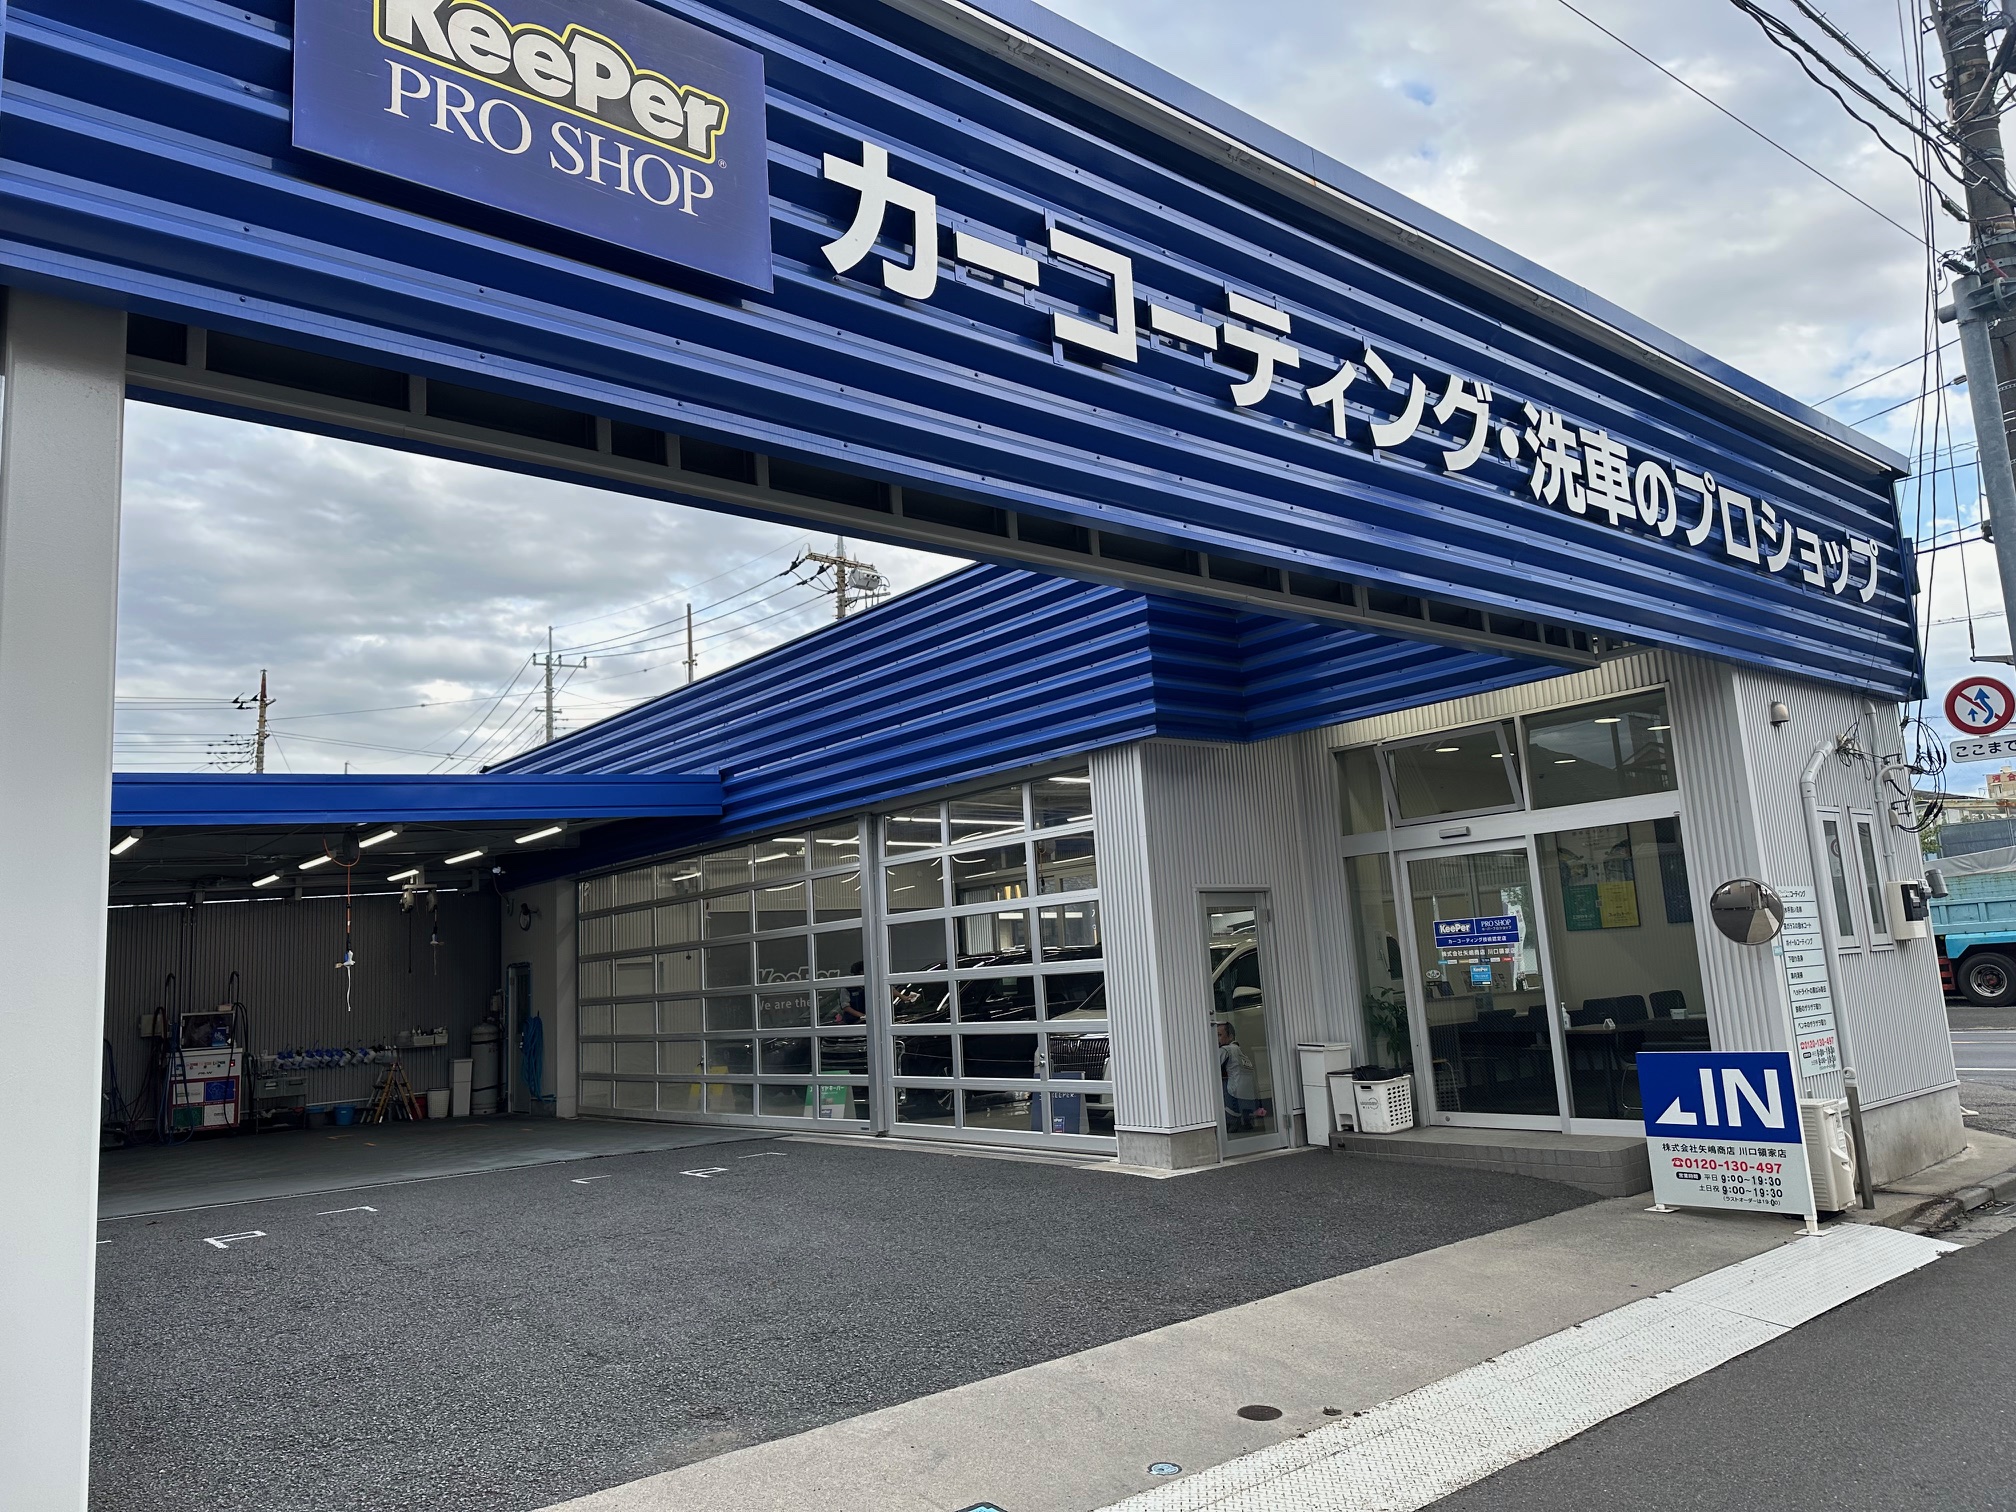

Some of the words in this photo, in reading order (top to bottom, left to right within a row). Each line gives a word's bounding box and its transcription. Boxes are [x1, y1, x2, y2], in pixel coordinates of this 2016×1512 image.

[385, 0, 721, 154] KeePer
[383, 59, 533, 156] PRO
[549, 121, 715, 217] SHOP
[821, 140, 1879, 603] カーコーティング・洗車のプロショップ
[1439, 923, 1470, 934] KeePer
[774, 1000, 792, 1010] are
[1698, 1068, 1785, 1129] IN
[1662, 1143, 1735, 1156] 株式会社矢嶋商店
[1739, 1146, 1787, 1158] 川口領家店
[1684, 1157, 1782, 1174] 0120-130-497
[1678, 1172, 1699, 1180] 営業時間
[1704, 1173, 1718, 1182] 平日
[1699, 1184, 1720, 1193] 土日祝
